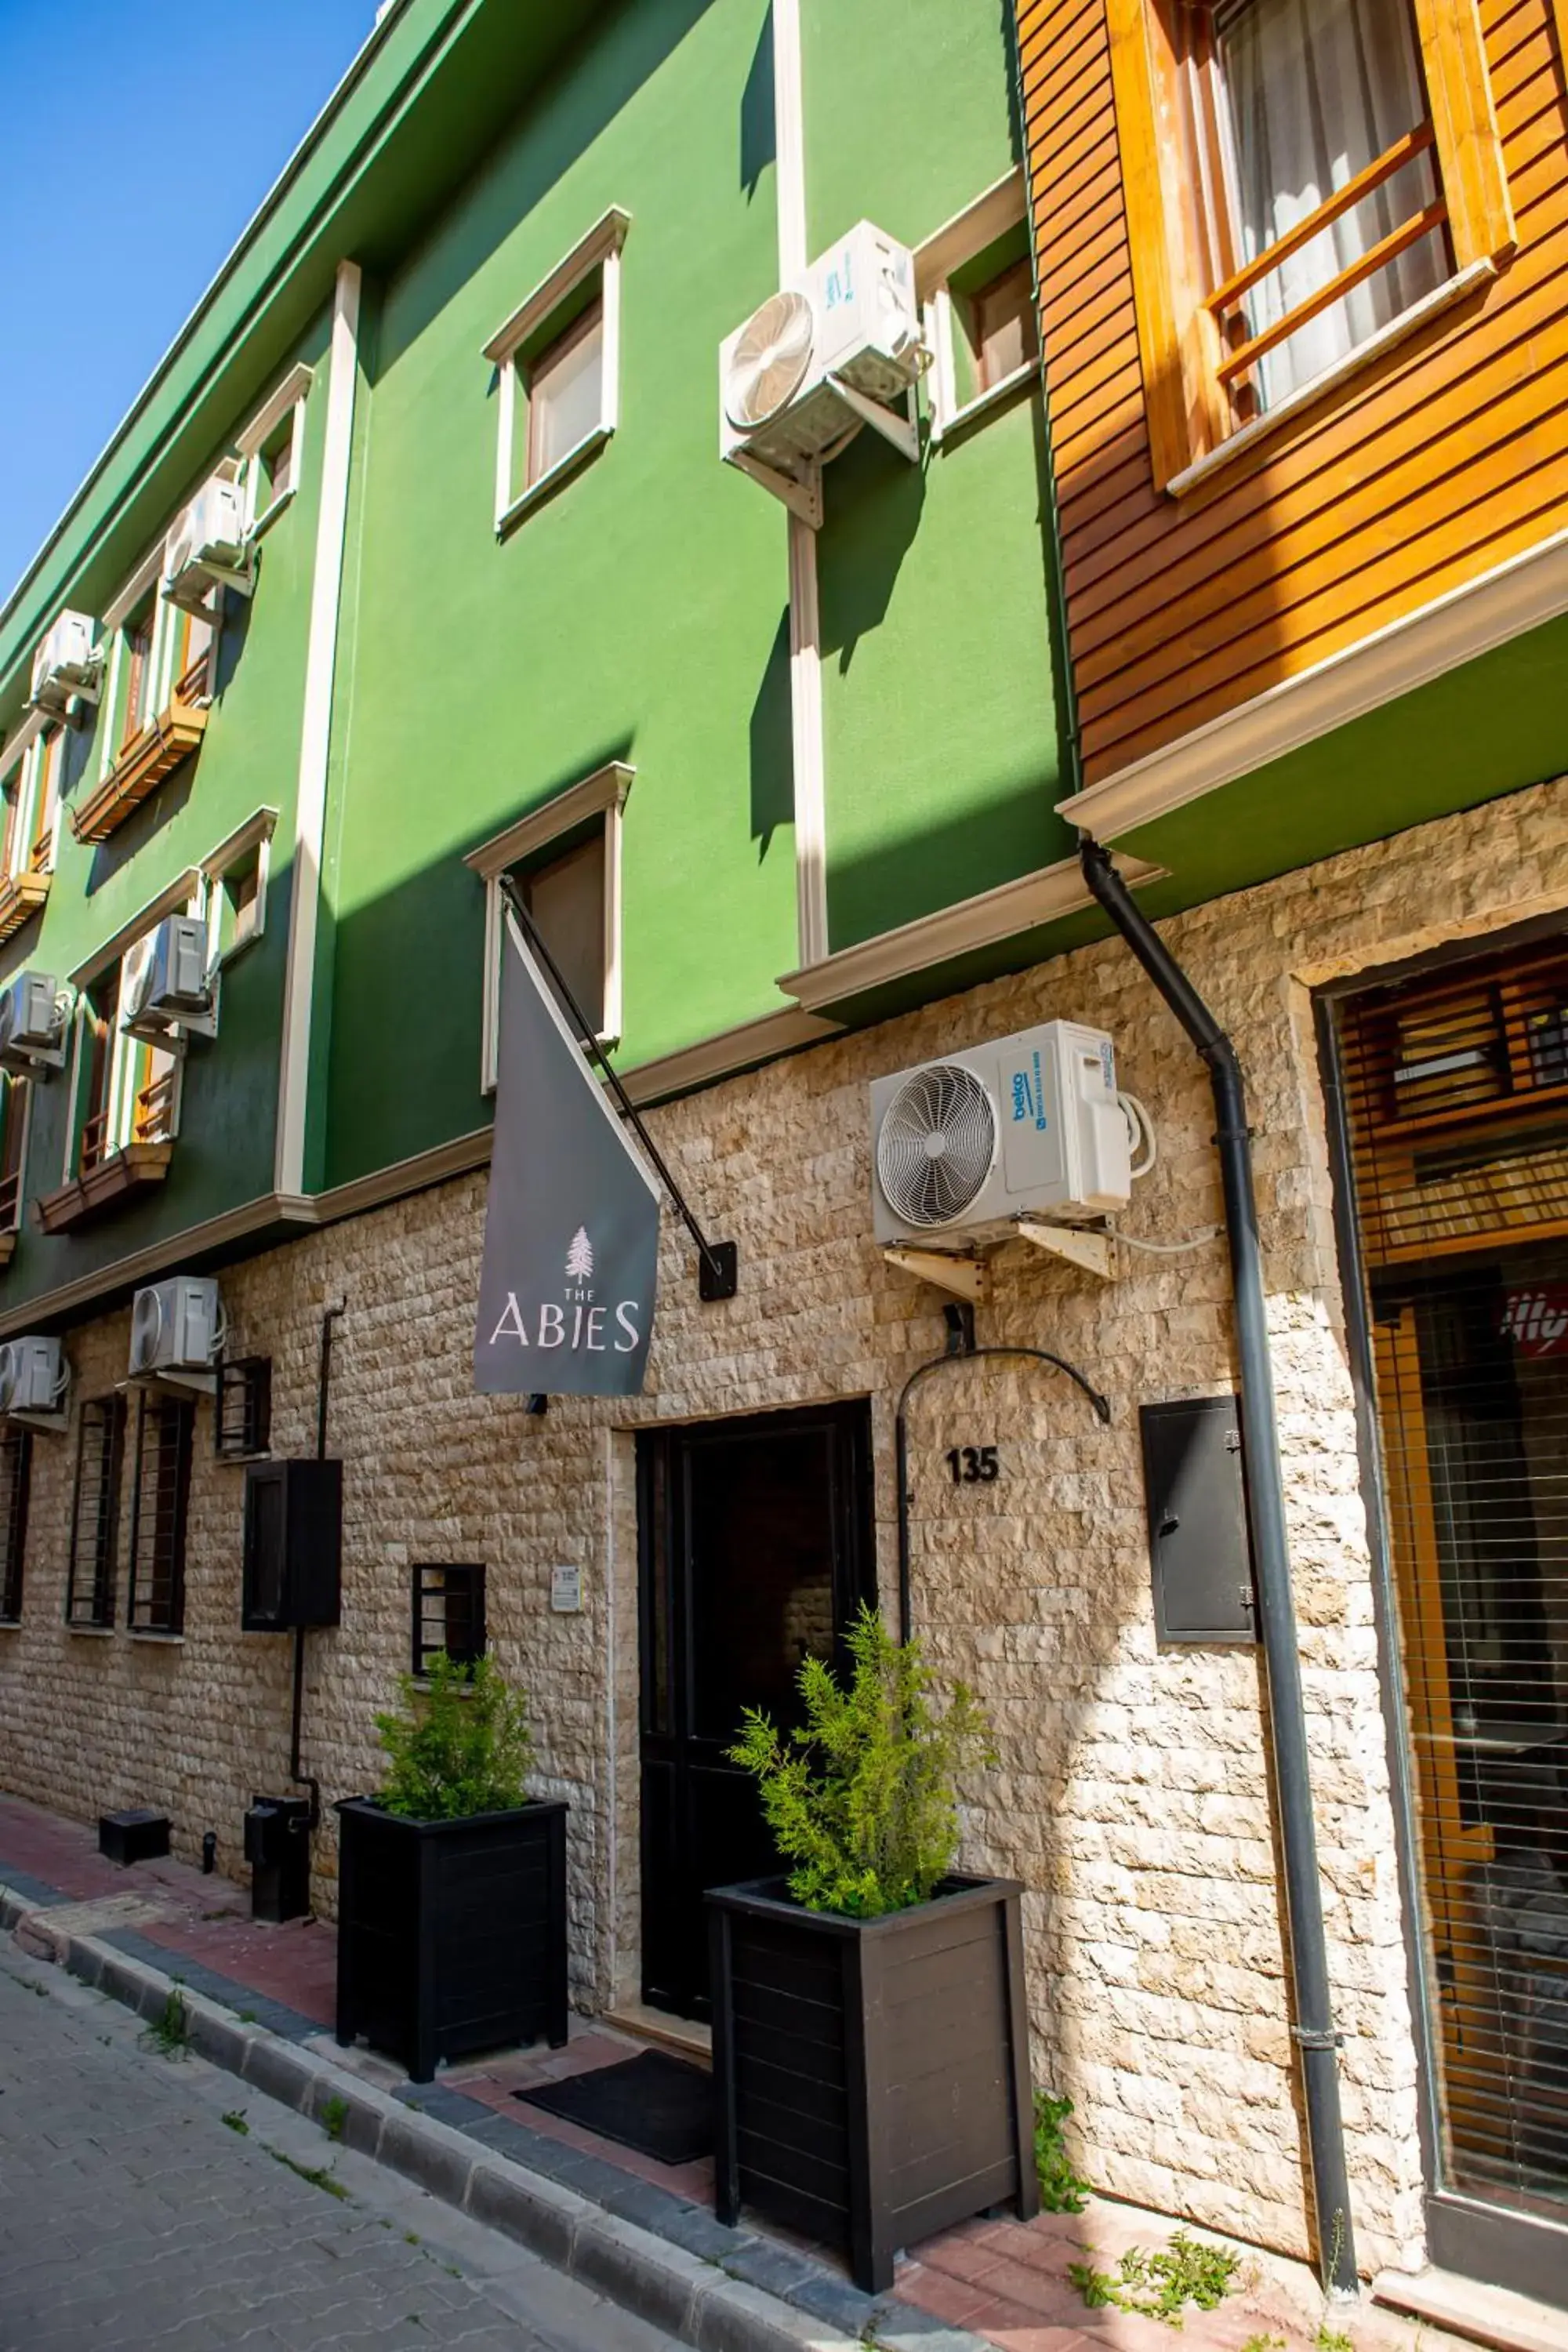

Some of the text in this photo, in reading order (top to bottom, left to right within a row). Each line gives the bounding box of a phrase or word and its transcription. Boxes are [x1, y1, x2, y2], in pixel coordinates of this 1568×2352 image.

[1012, 1072, 1025, 1122] beko
[564, 1288, 595, 1302] THE
[488, 1292, 640, 1352] ABIES
[1500, 1292, 1568, 1354] illy
[946, 1446, 999, 1486] 135
